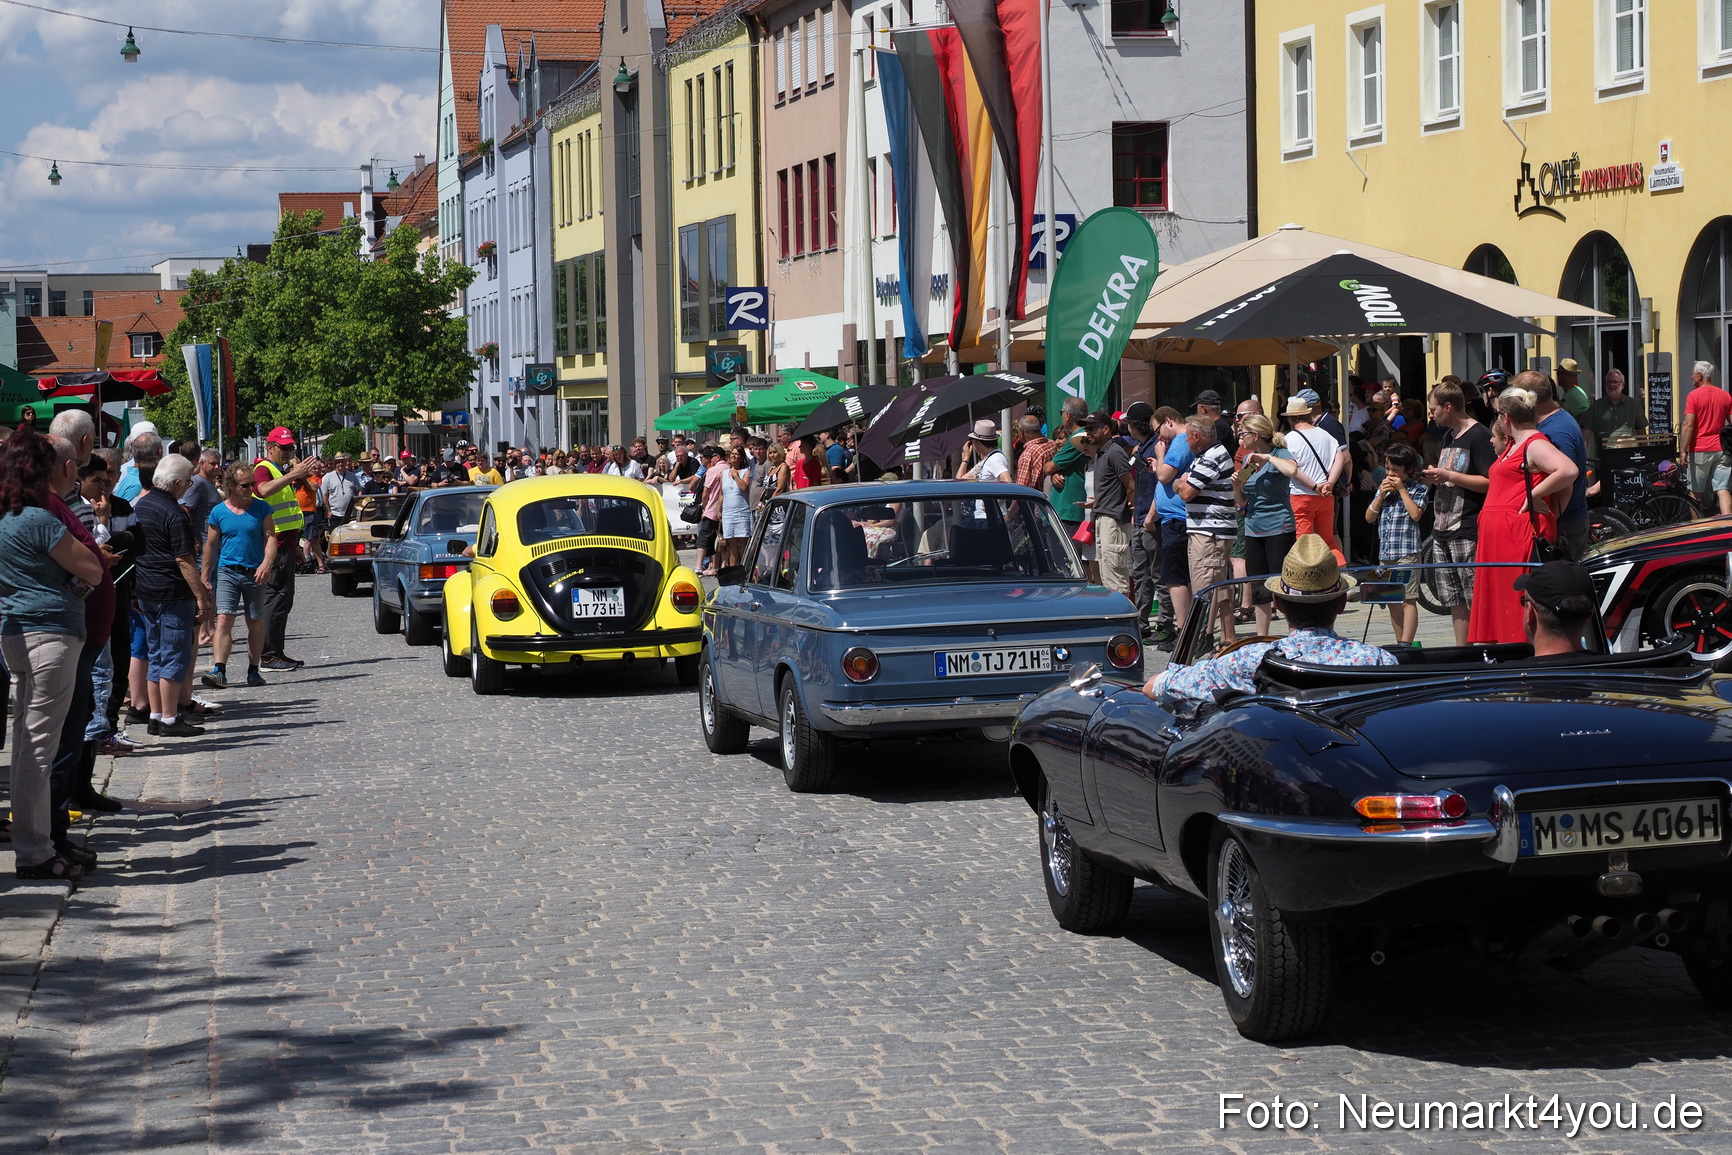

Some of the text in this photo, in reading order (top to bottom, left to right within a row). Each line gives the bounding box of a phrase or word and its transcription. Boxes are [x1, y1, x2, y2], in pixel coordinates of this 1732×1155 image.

[1580, 169, 1597, 193] AM
[1597, 161, 1643, 191] RATHAUS
[1653, 165, 1676, 176] Neumarkter
[1650, 174, 1680, 189] Lammsbräu
[1078, 254, 1148, 362] DEKRA
[1352, 283, 1405, 323] now
[744, 375, 780, 385] Klostergasse
[592, 589, 608, 602] NM
[575, 602, 616, 617] JT 73 H
[947, 653, 970, 674] NM
[1534, 815, 1557, 851] M
[1580, 811, 1624, 848] MS
